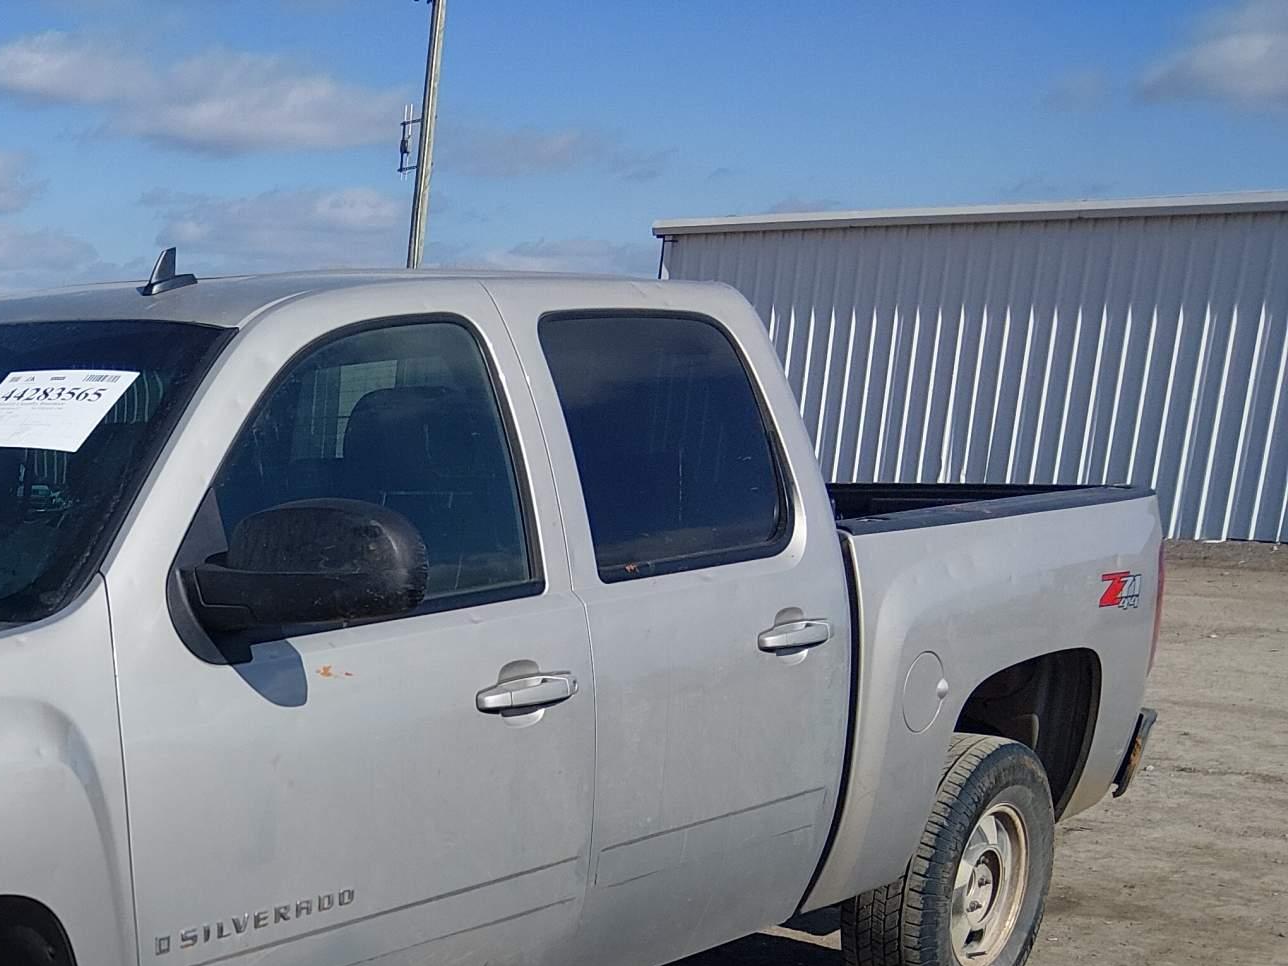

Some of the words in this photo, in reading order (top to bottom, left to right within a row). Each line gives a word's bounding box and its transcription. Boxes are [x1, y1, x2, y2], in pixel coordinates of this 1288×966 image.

[1, 386, 109, 402] 44283565
[1098, 570, 1142, 608] Z71
[180, 887, 355, 949] SILVERADO
